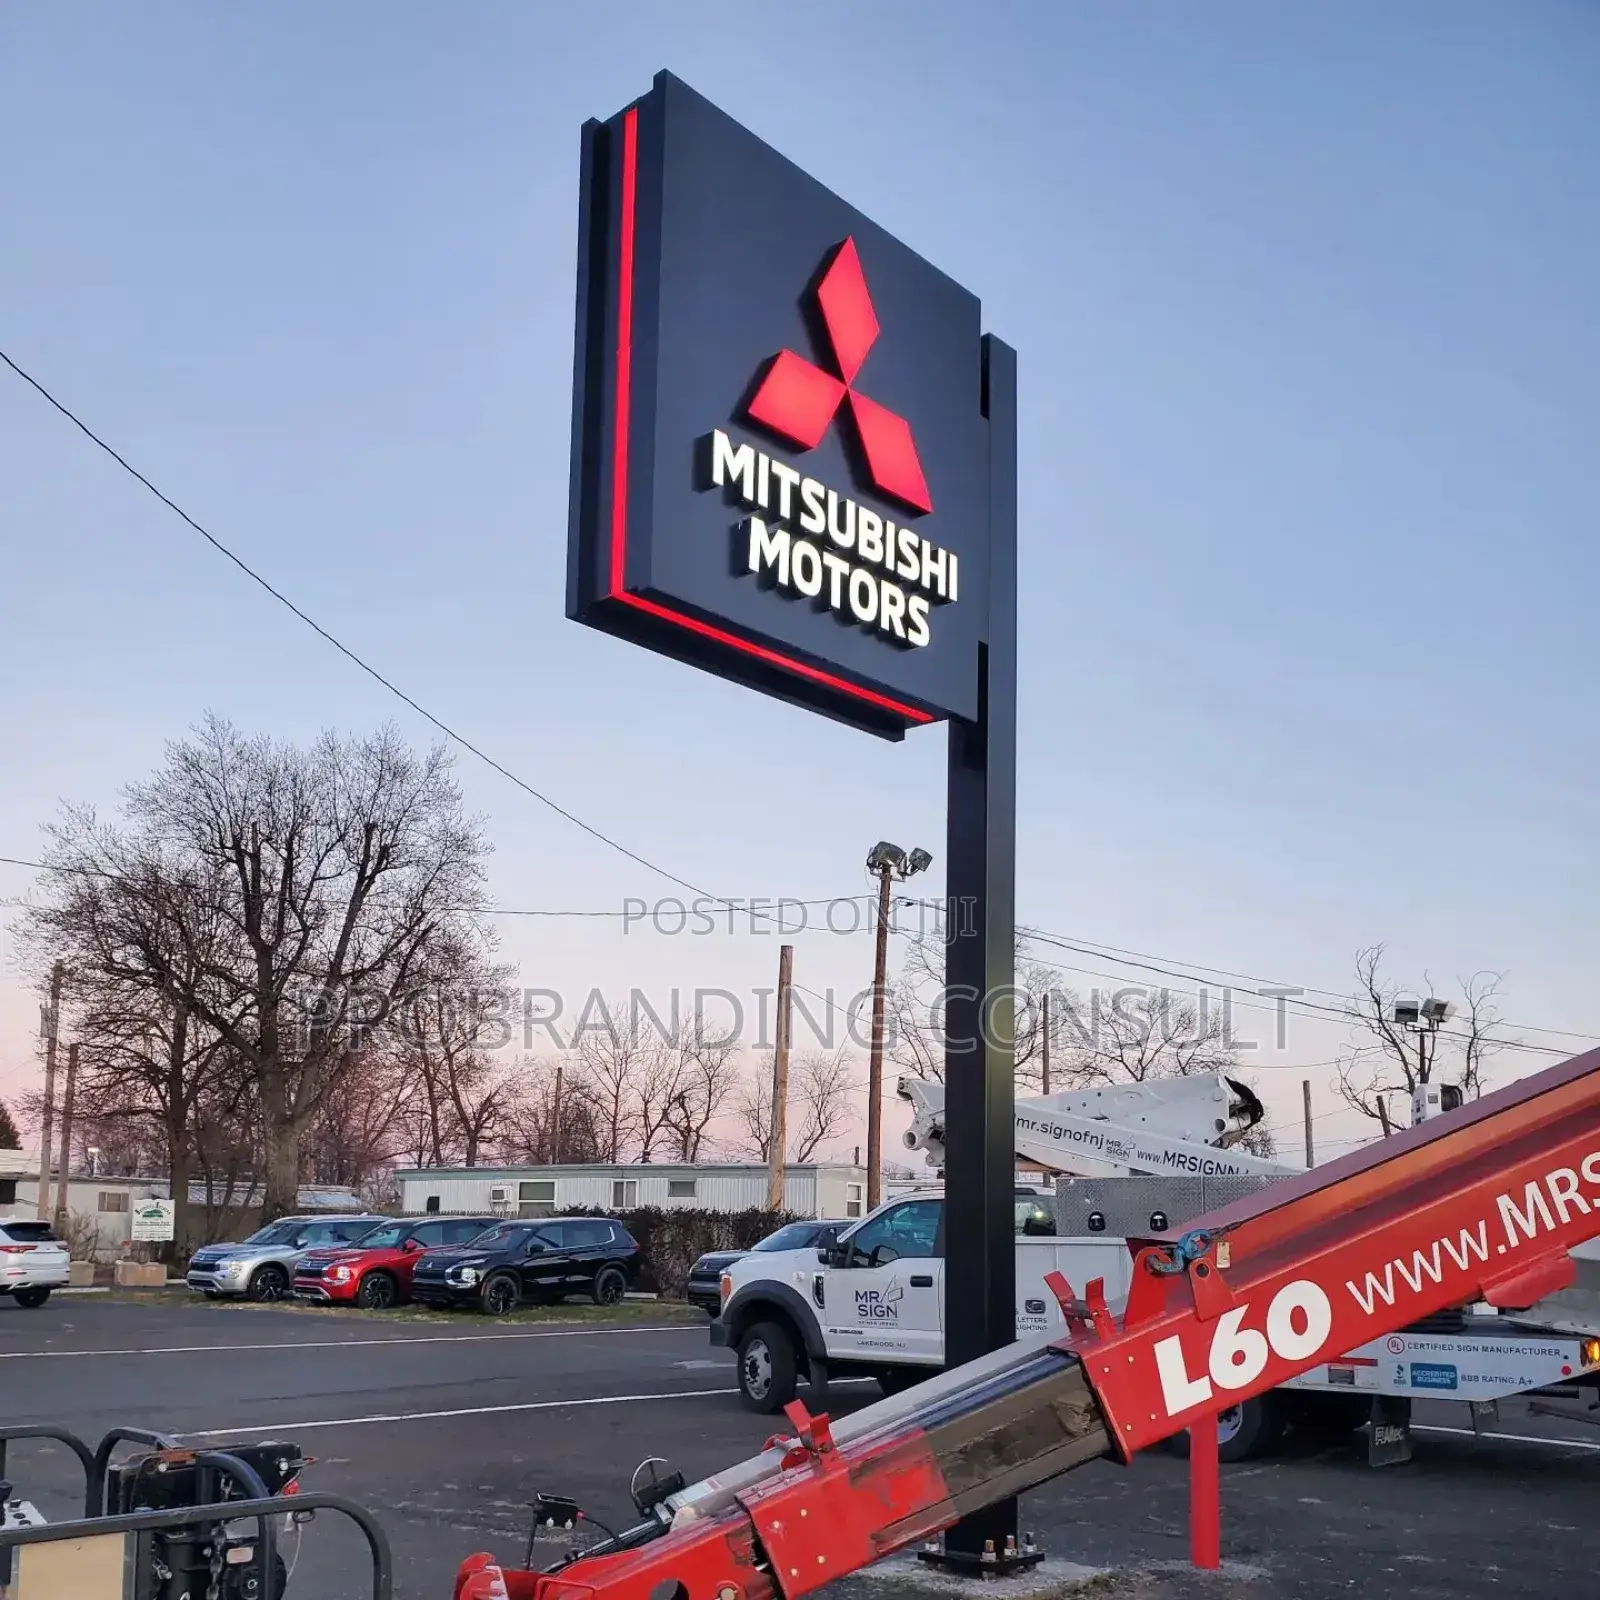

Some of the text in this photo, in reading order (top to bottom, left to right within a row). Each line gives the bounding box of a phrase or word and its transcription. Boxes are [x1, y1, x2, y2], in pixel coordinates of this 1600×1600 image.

[712, 428, 958, 602] MITSUBISHI
[748, 516, 931, 648] MOTORS
[1016, 1117, 1105, 1149] mr.signofnj
[1106, 1139, 1122, 1148] MR
[1106, 1147, 1131, 1158] SIGN
[1137, 1150, 1249, 1175] www.MRSIGNN
[855, 1290, 880, 1303] MR
[858, 1304, 898, 1318] SIGN
[1153, 1279, 1332, 1417] L60
[1407, 1341, 1561, 1358] CERTIFIED SIGN MANUFACTURER
[1412, 1370, 1456, 1379] ACCREDITED
